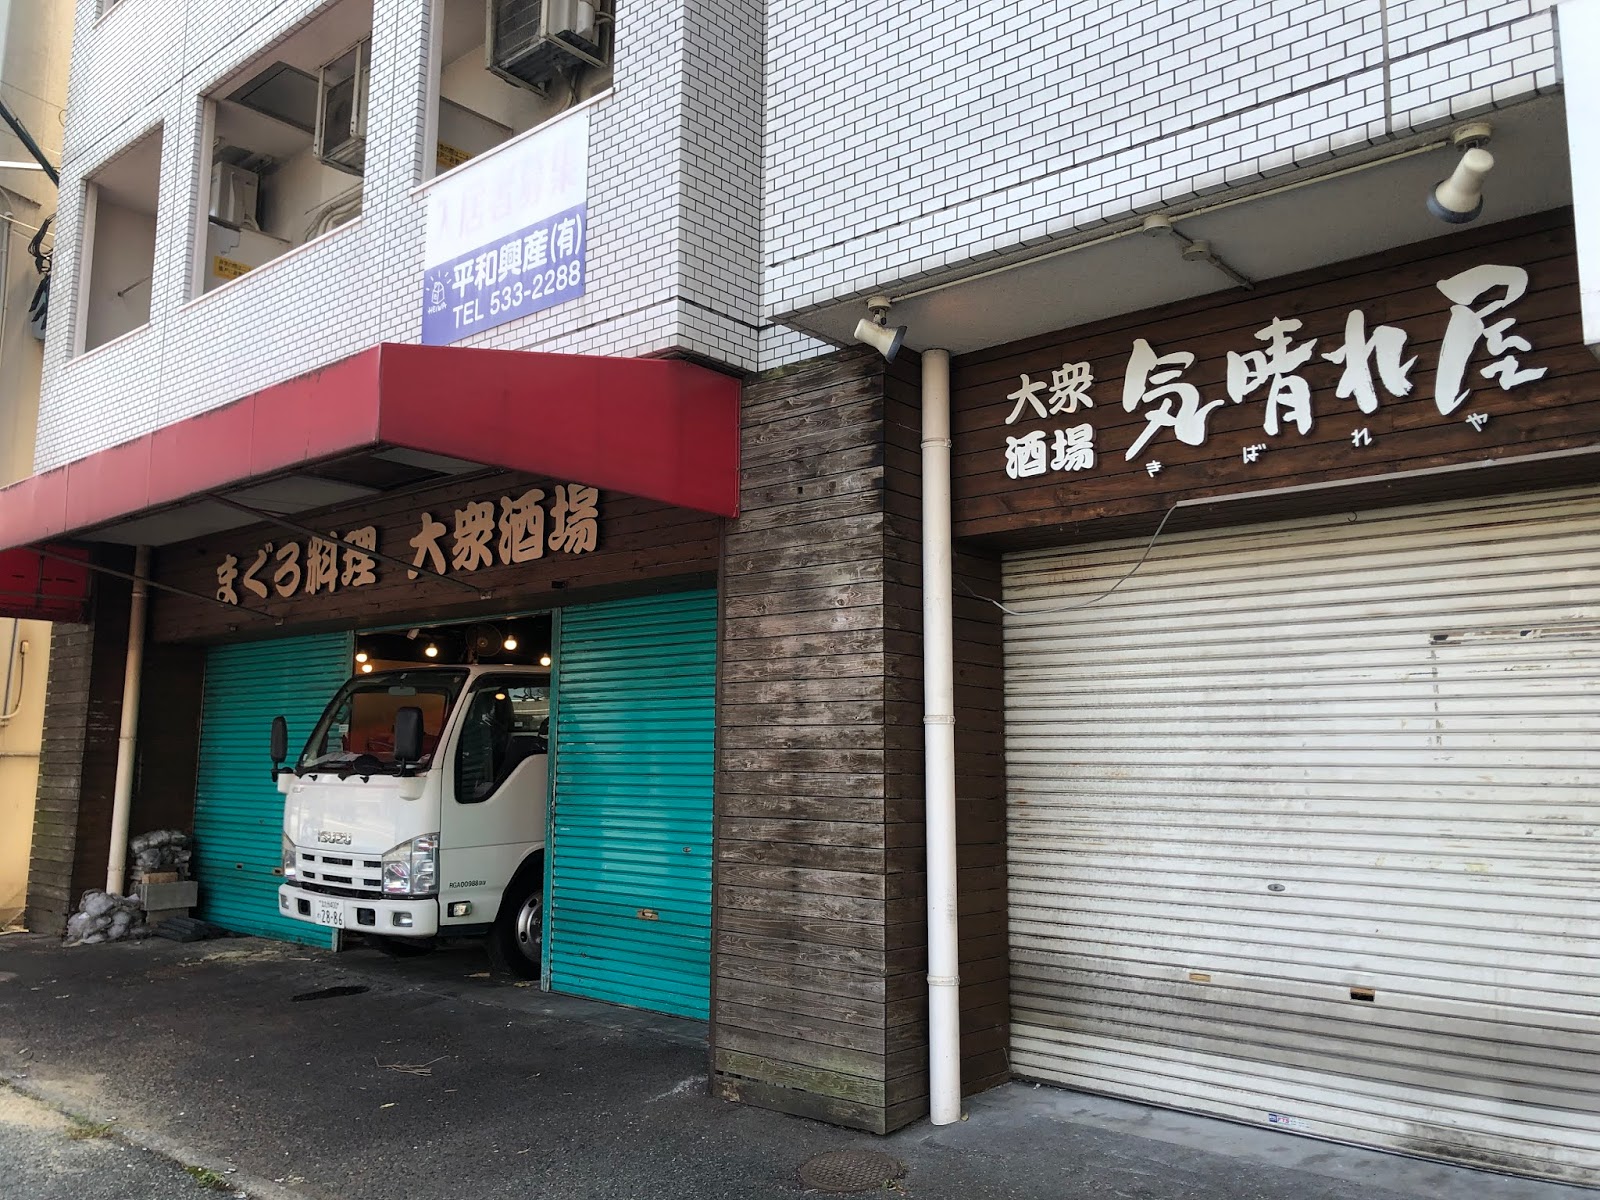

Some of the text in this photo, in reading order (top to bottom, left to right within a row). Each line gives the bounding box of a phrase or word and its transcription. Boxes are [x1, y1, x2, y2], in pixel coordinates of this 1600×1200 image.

[452, 214, 582, 298] 平和興産(有)
[453, 260, 581, 329] TEL 533-2288
[1004, 361, 1095, 426] 大衆
[1123, 264, 1548, 461] 気晴れ屋
[1004, 423, 1095, 479] 酒場
[216, 483, 599, 605] まぐろ料理 大衆酒場
[317, 831, 352, 845] ISUZU
